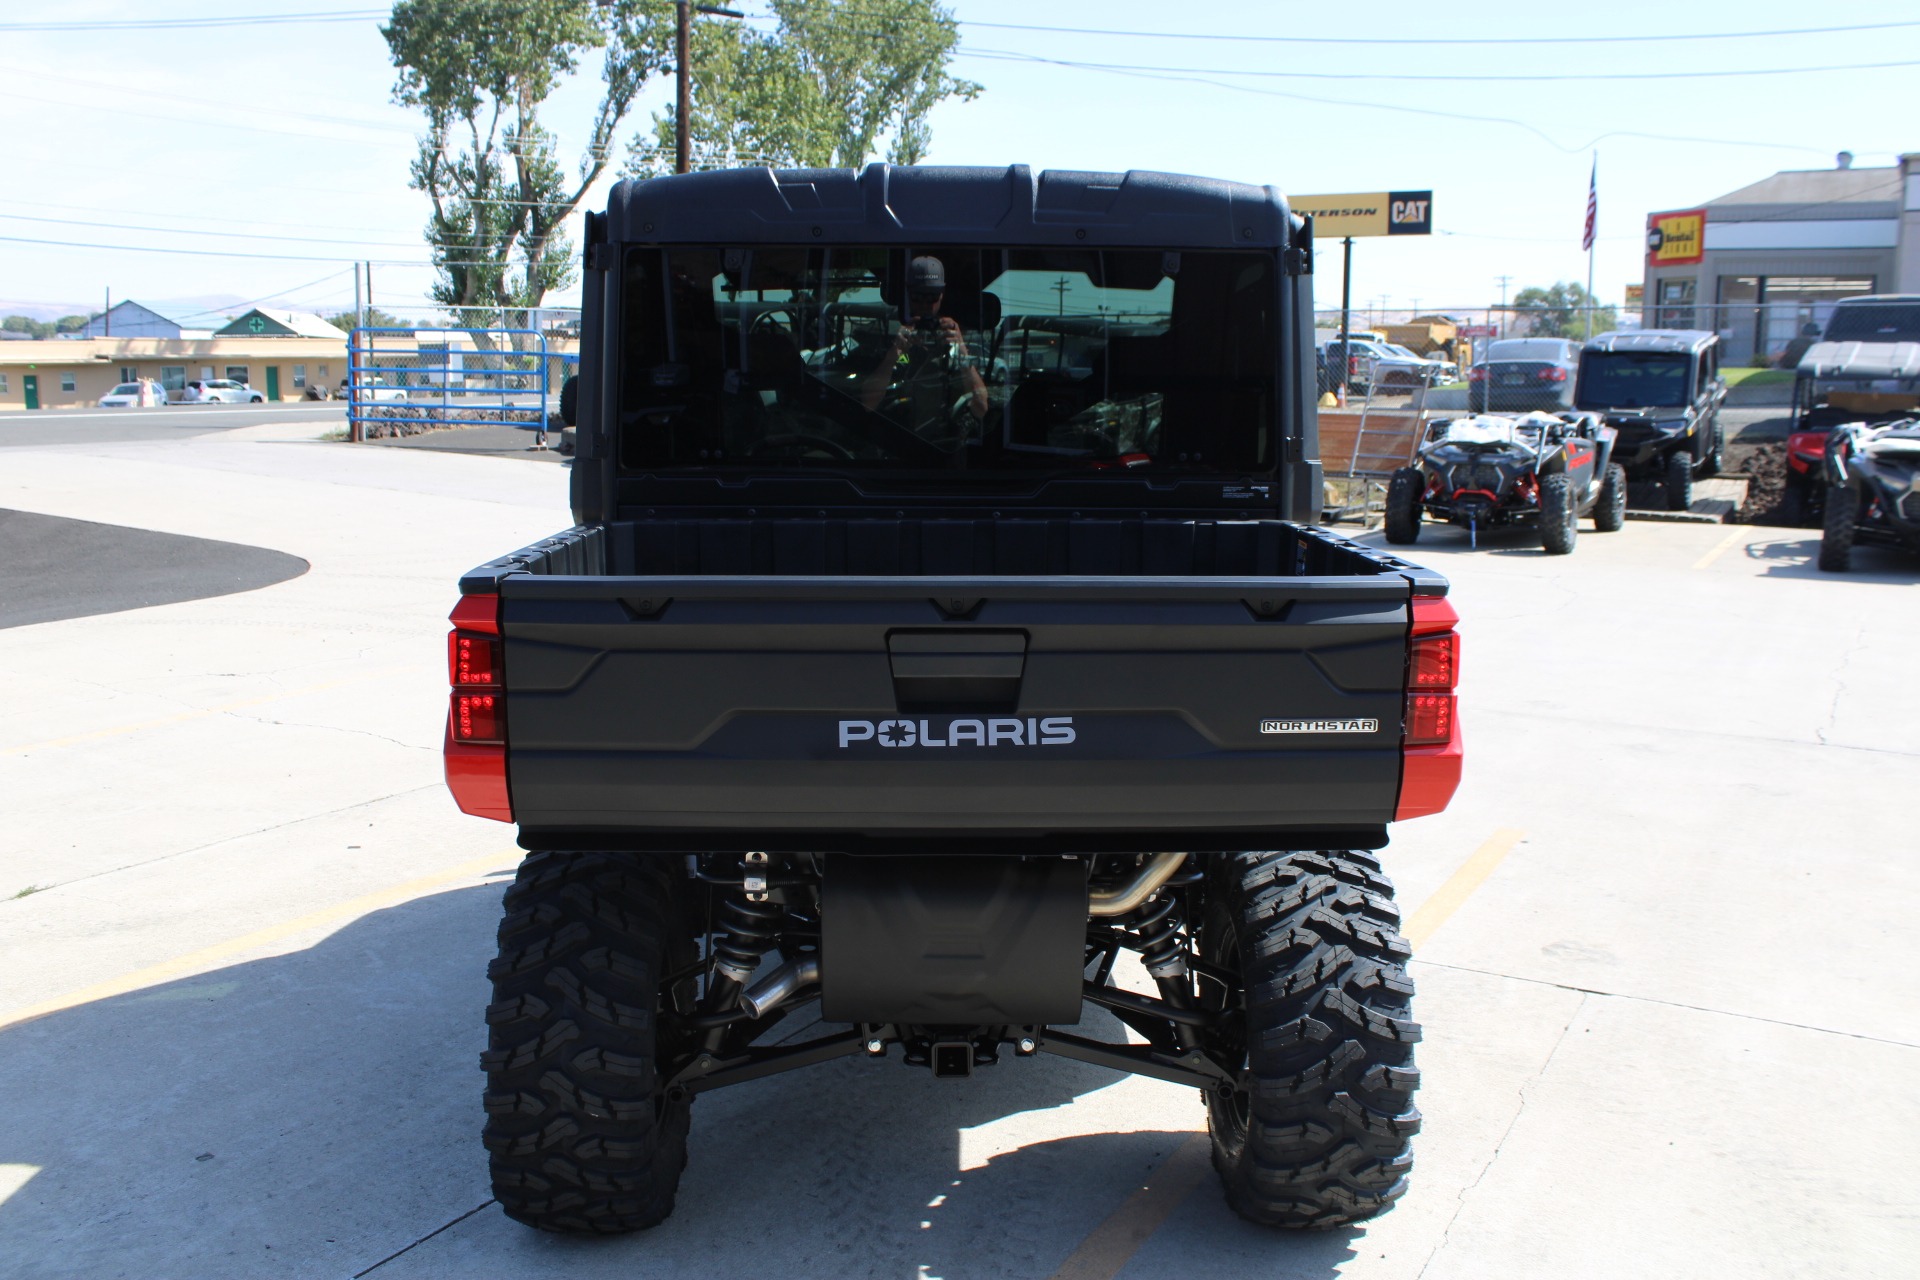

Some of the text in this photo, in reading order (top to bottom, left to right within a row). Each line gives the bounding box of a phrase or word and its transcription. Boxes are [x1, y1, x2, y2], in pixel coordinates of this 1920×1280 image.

[1391, 200, 1429, 224] CAT
[838, 716, 1077, 748] POLARIS
[1266, 721, 1373, 731] NORTHSTAR
